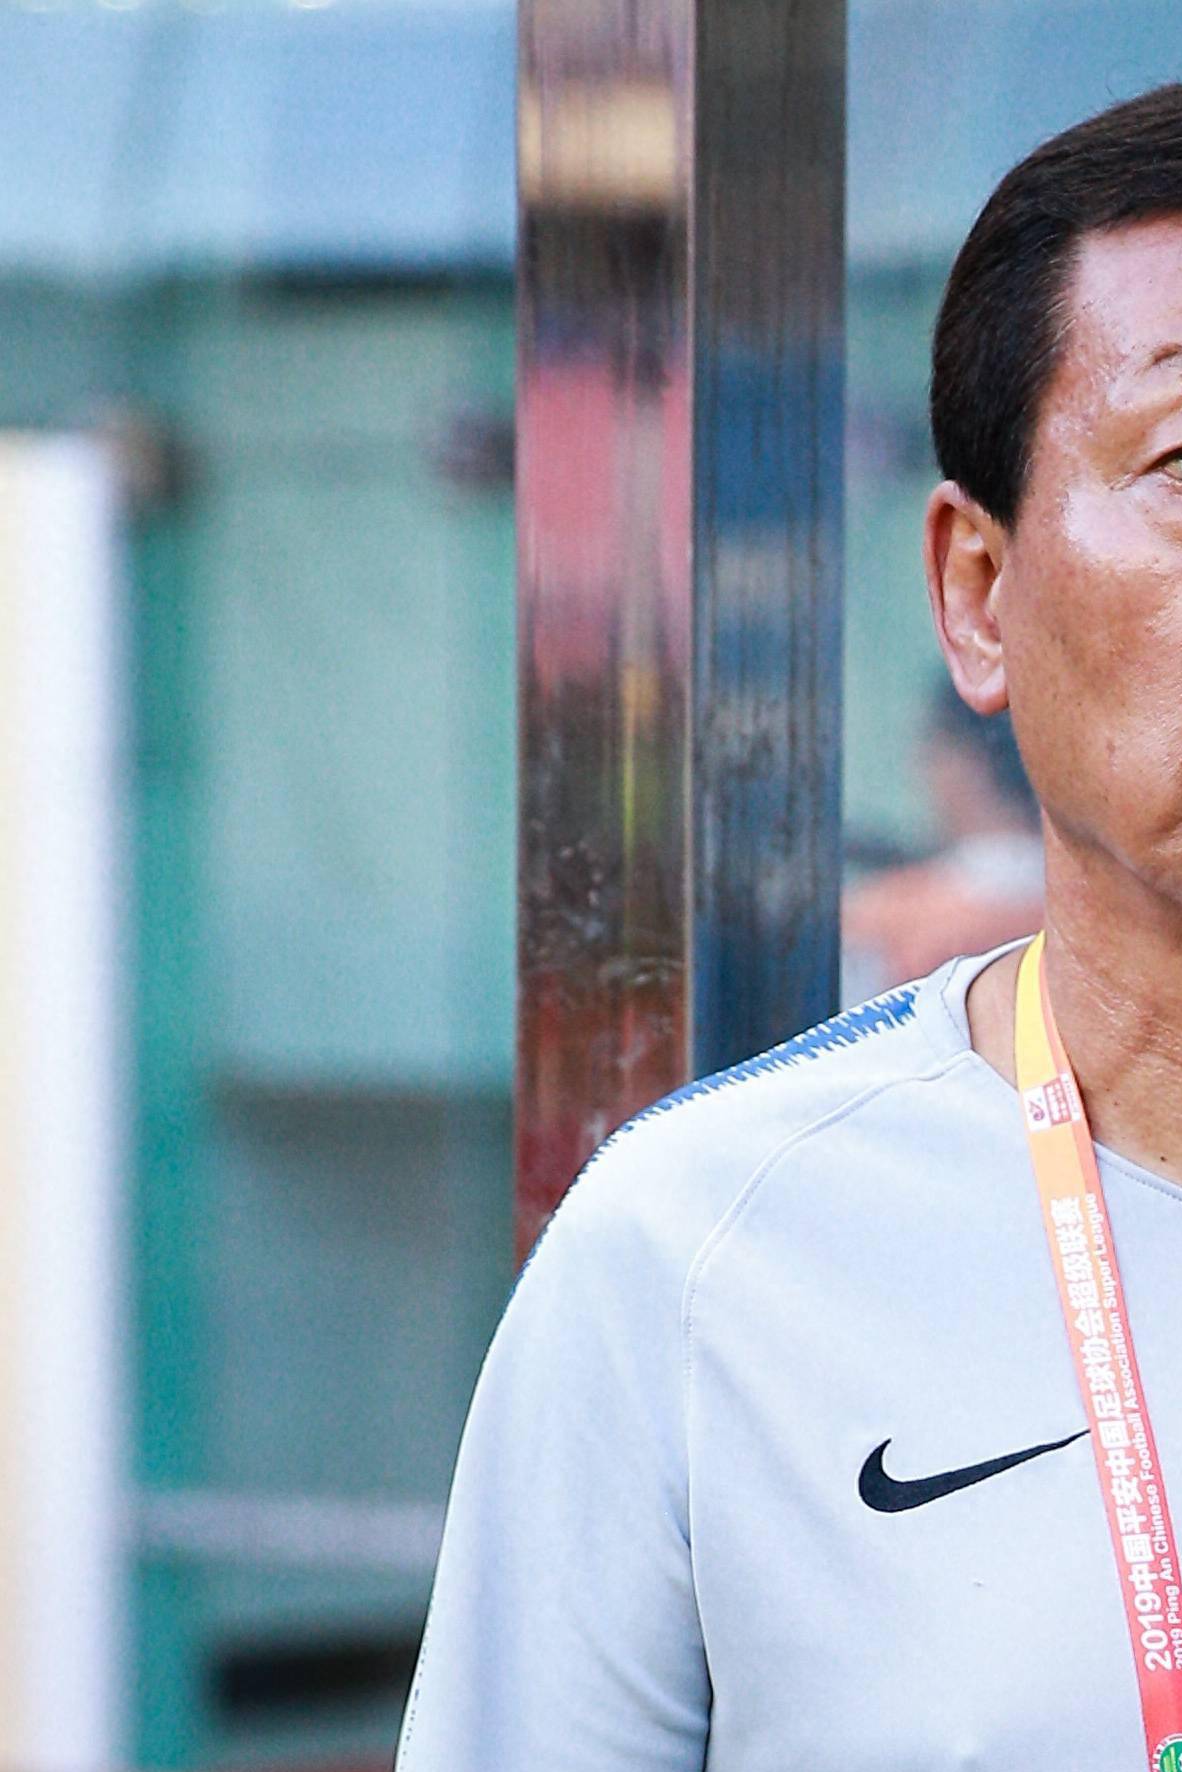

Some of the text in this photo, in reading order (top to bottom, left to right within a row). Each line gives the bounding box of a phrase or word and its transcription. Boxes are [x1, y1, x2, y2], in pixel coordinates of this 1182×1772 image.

[1084, 1192, 1110, 1256] League
[1098, 1256, 1118, 1309] Super
[1109, 1311, 1140, 1408] Association
[1127, 1411, 1155, 1481] Football
[1146, 1484, 1169, 1555] Chinese
[1159, 1557, 1174, 1581] An
[1167, 1585, 1181, 1624] Ping
